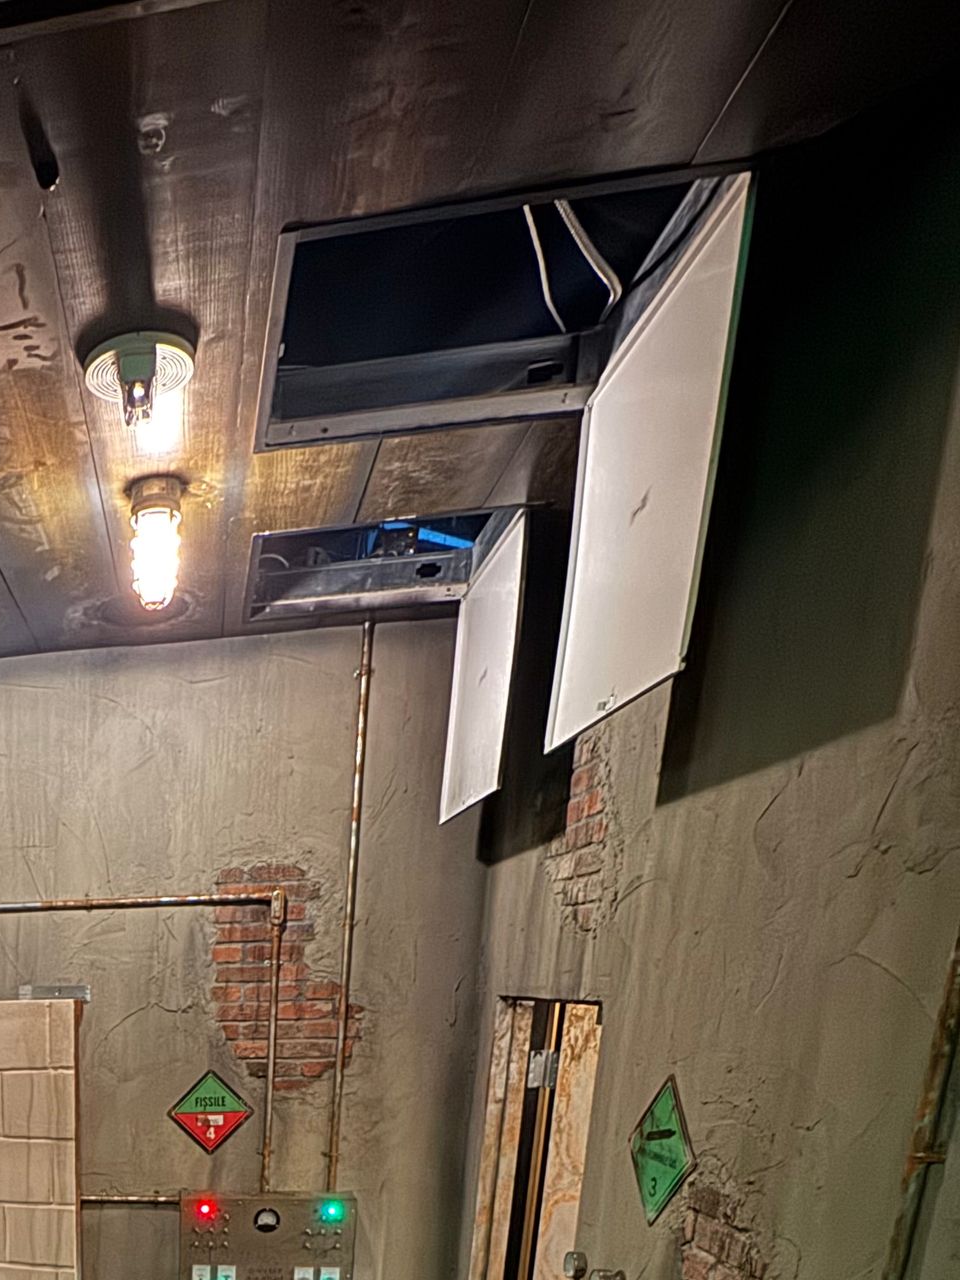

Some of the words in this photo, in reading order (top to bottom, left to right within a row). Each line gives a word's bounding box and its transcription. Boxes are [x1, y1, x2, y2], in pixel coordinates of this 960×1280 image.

[195, 1096, 226, 1108] FISSILE
[206, 1127, 215, 1140] 4
[649, 1176, 657, 1197] 3
